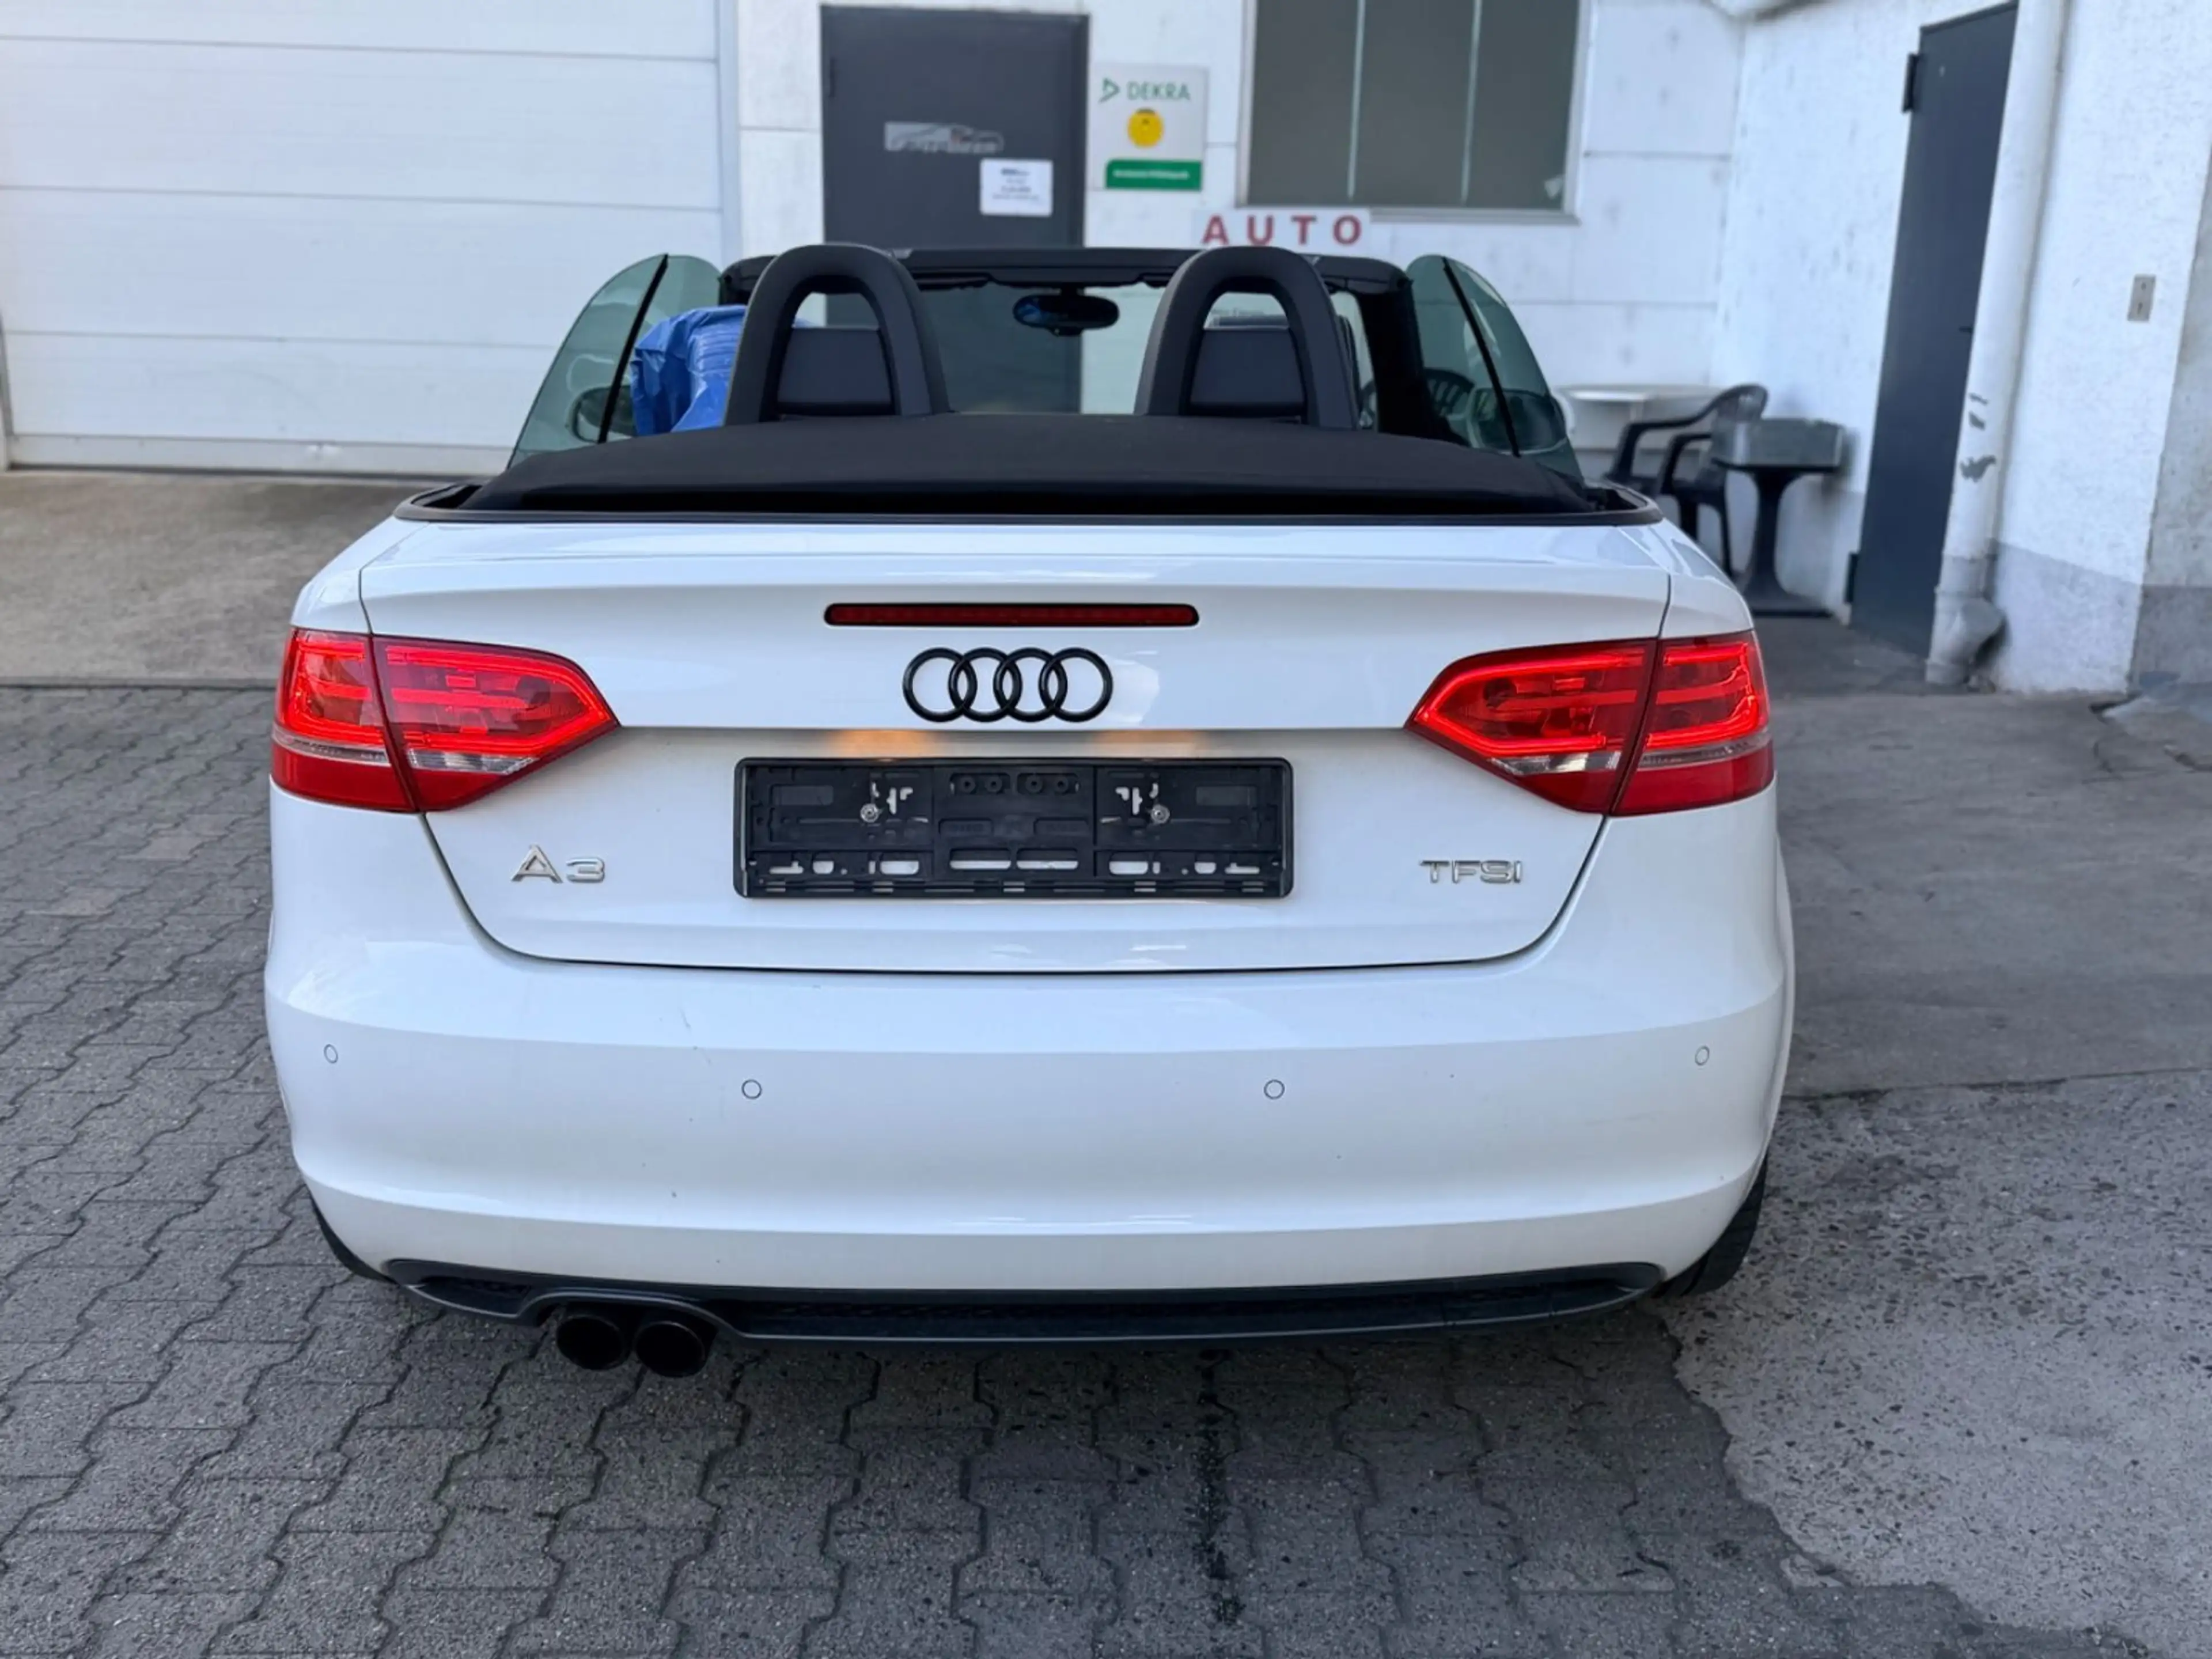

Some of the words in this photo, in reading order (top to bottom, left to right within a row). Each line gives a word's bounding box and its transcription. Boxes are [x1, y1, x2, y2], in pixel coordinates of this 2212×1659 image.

[1127, 81, 1191, 100] DEKRA
[1201, 215, 1362, 245] AUTO
[511, 844, 605, 883] A3
[1419, 860, 1522, 884] TFSI
